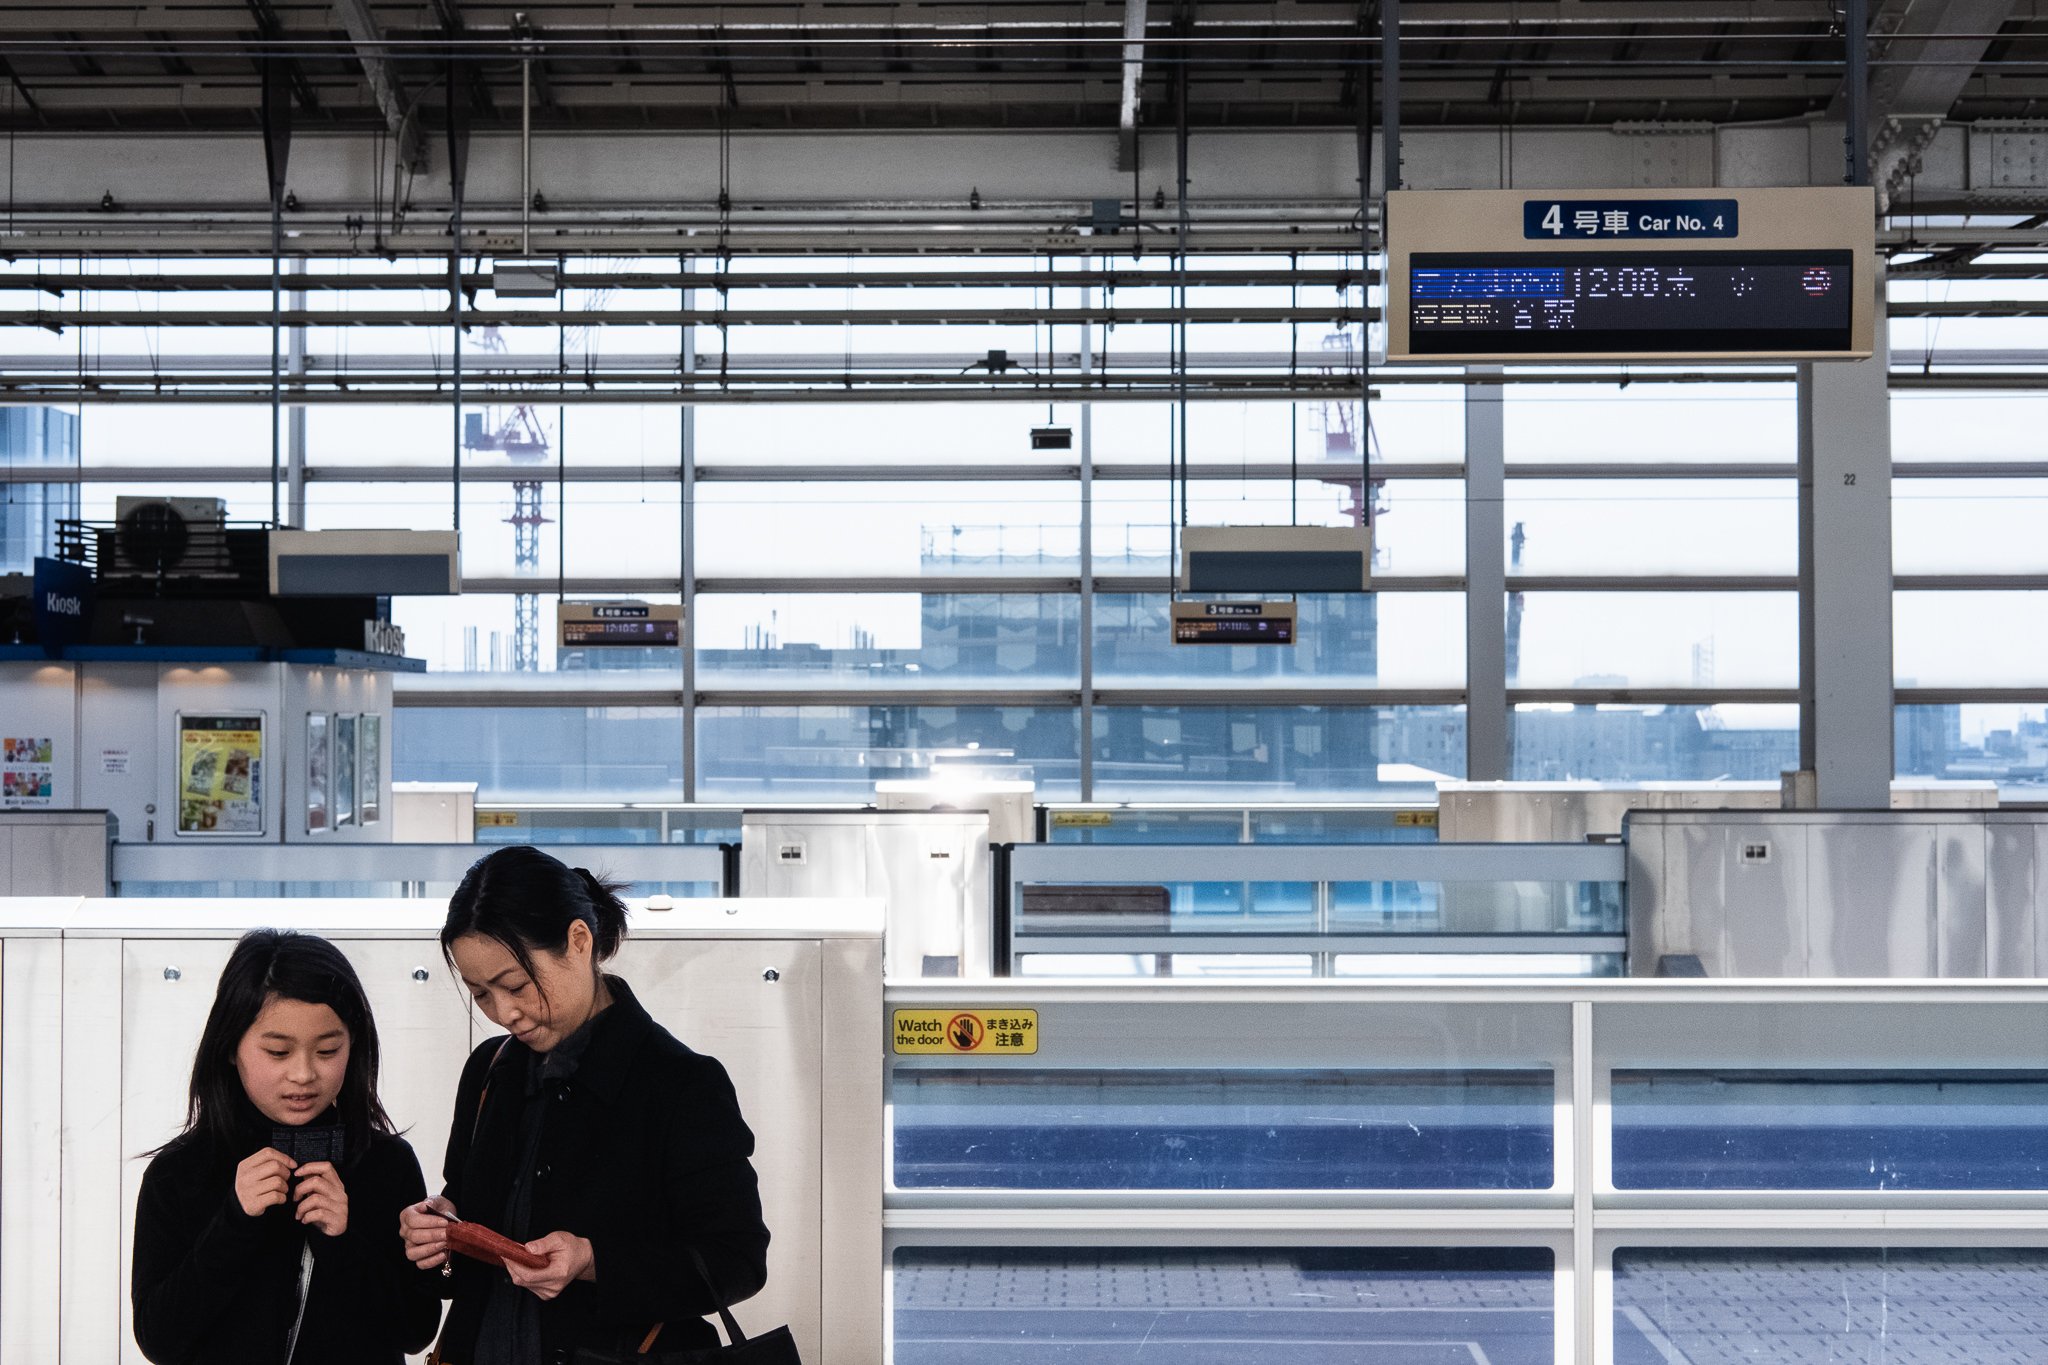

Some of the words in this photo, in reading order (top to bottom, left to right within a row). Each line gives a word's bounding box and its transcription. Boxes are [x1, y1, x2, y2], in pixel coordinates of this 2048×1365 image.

[1638, 215, 1671, 231] Car
[1676, 215, 1706, 231] No.
[1713, 215, 1724, 230] 4
[1843, 472, 1857, 486] 22
[47, 592, 81, 616] Kiosk
[364, 616, 405, 657] Kiosk
[898, 1019, 942, 1032] Watch
[986, 1018, 1033, 1030] まき込み
[896, 1034, 915, 1045] the
[918, 1034, 945, 1045] door
[995, 1033, 1024, 1047] 注意
